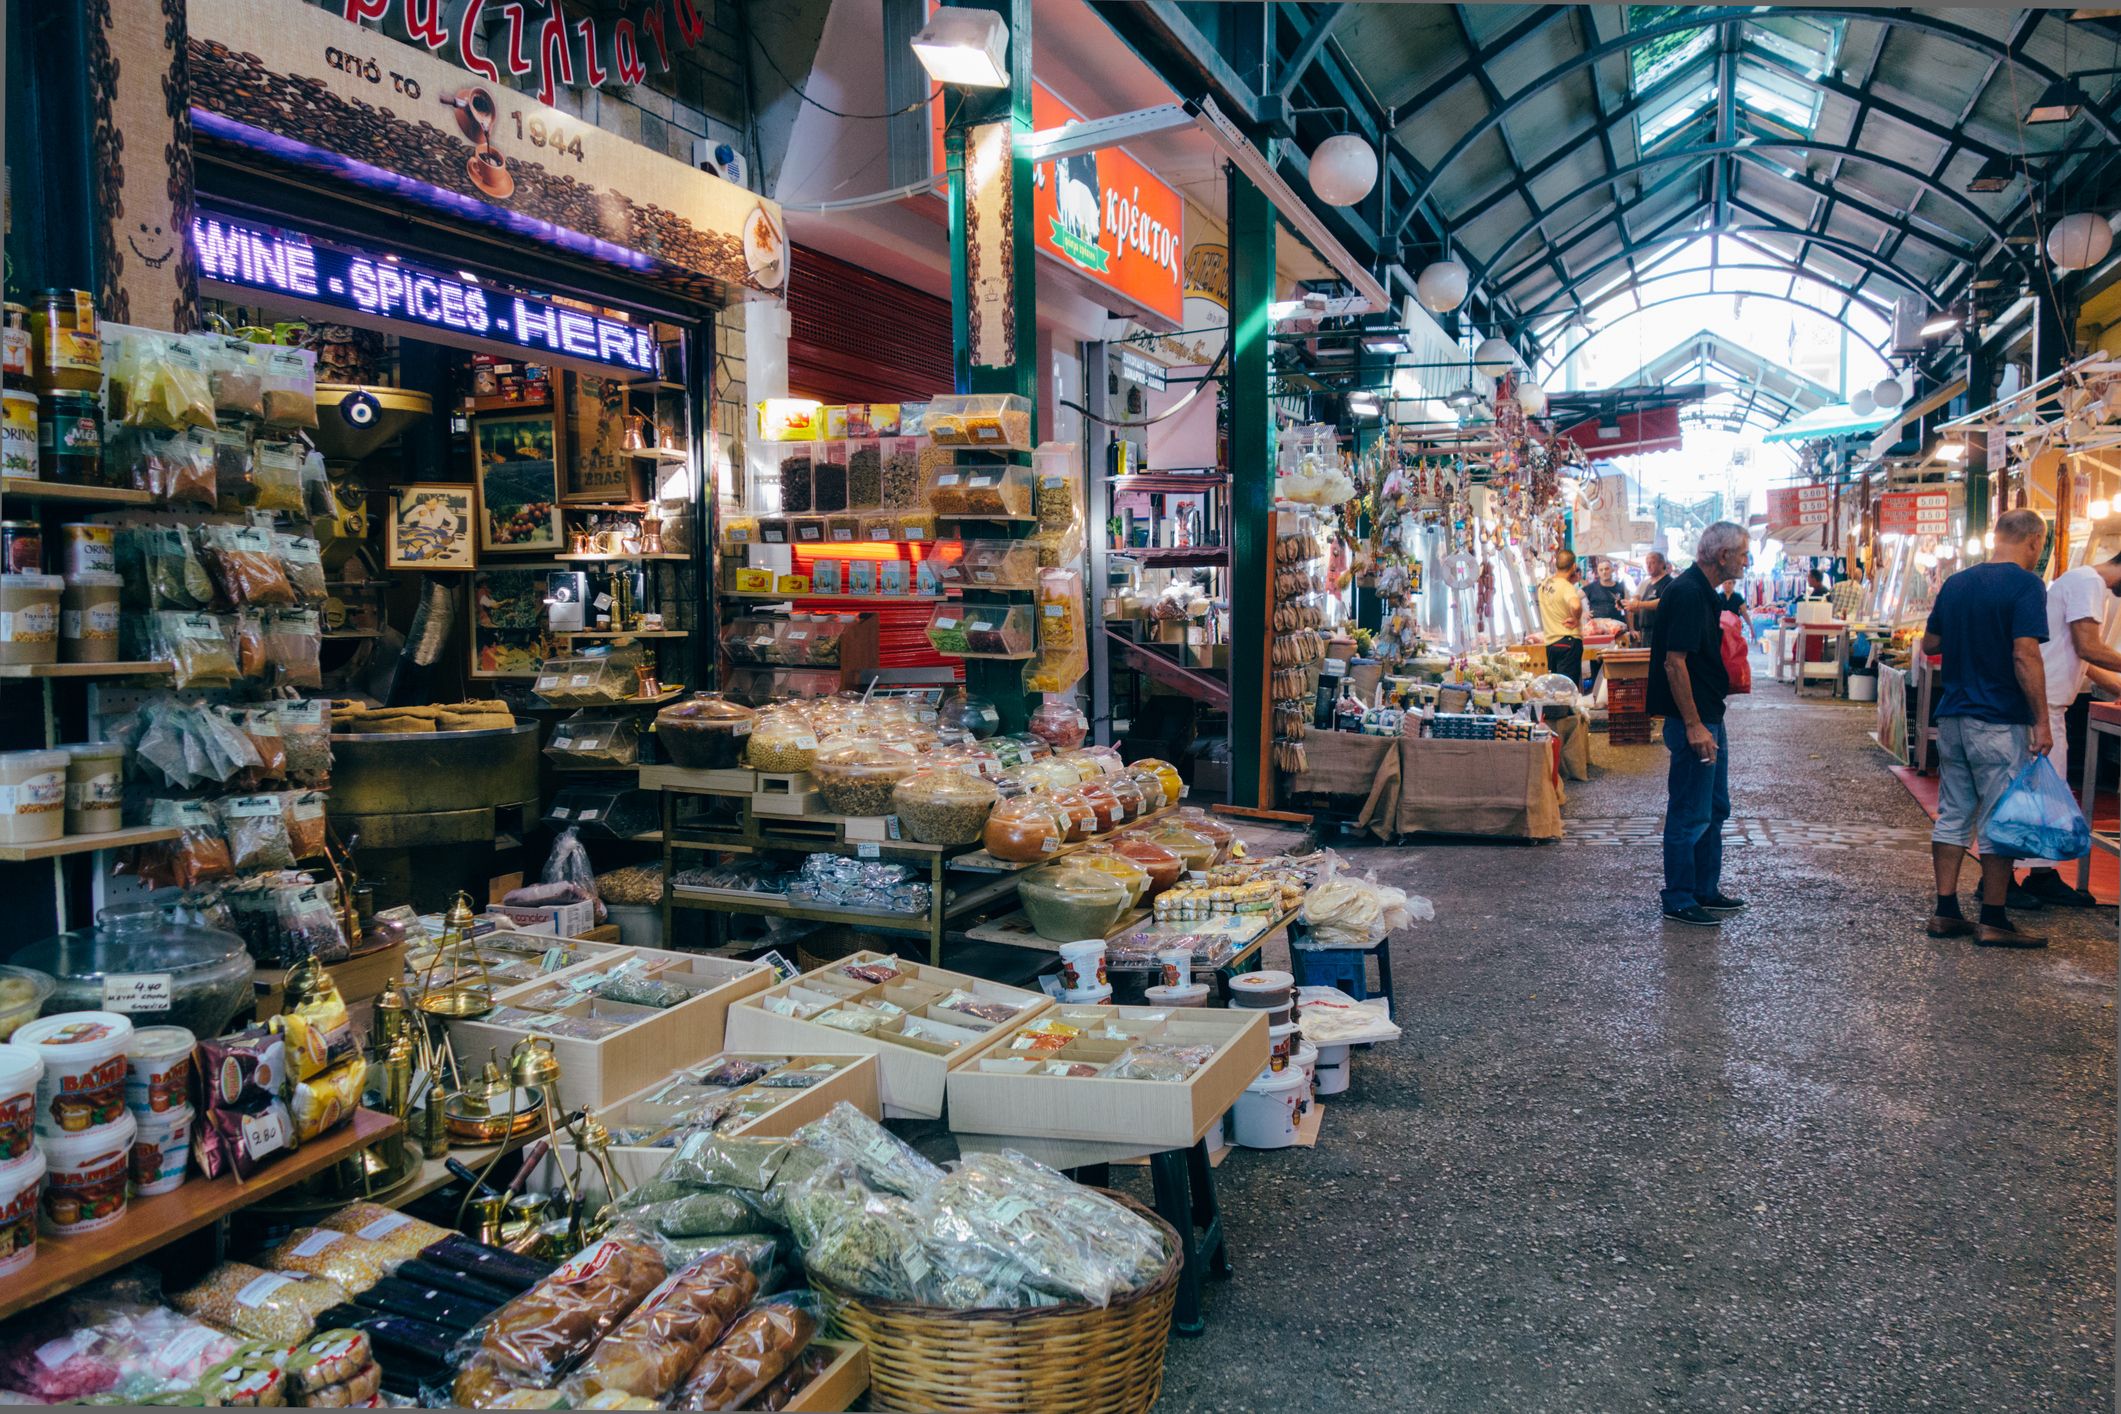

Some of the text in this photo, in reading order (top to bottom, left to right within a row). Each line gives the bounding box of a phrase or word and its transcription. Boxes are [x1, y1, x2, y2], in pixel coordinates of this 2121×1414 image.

[325, 46, 421, 99] από το
[511, 110, 584, 163] 1944
[1106, 186, 1178, 286] κρέατος
[193, 217, 318, 296] WINE
[351, 257, 489, 332] SPICES
